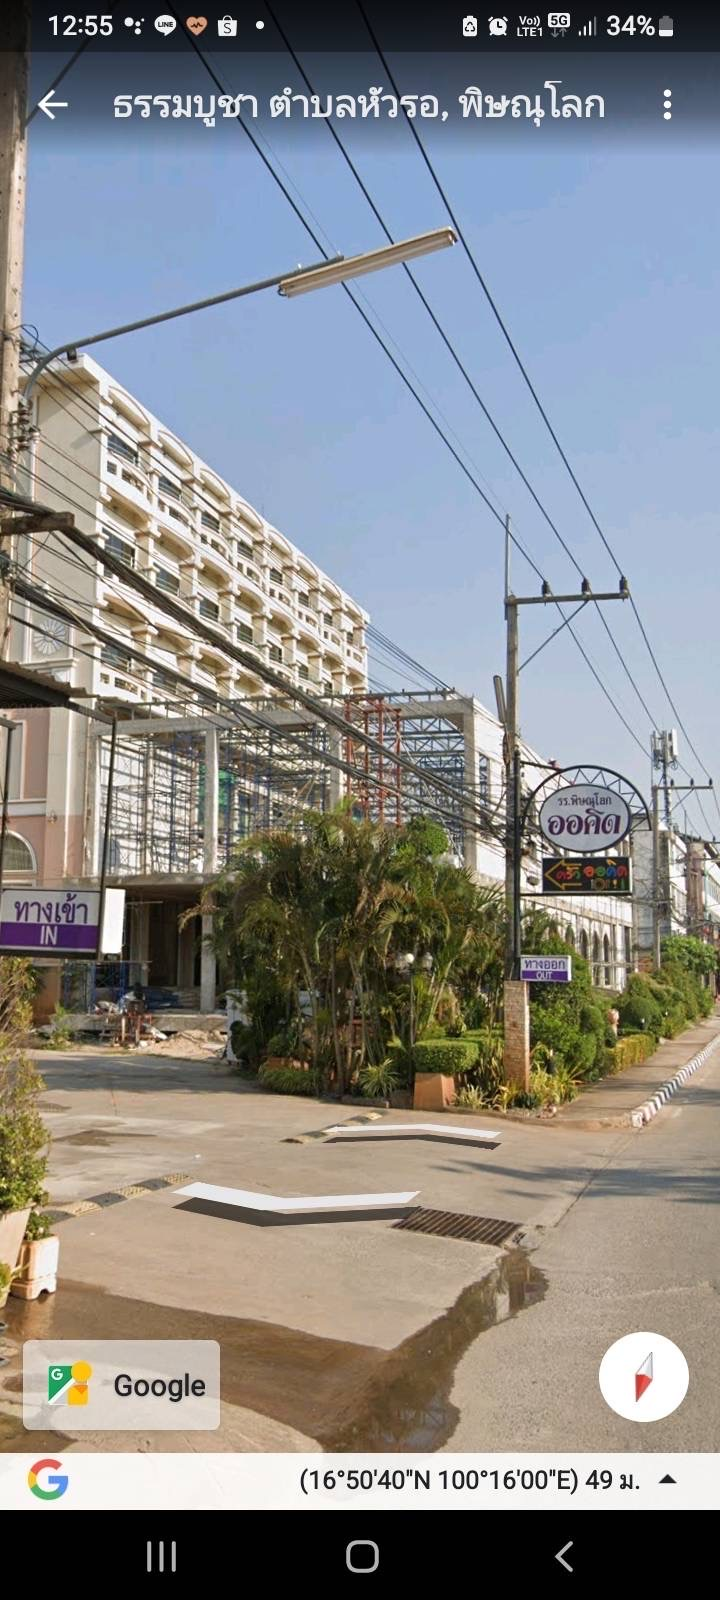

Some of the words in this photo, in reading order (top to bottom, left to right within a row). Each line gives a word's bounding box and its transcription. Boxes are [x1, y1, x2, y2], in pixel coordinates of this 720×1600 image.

[557, 793, 612, 808] รร.พิษณุโลก
[548, 808, 621, 836] ออคิด
[583, 859, 628, 878] ออคิด
[14, 893, 89, 924] ทางเข้า
[40, 926, 58, 946] IN
[524, 959, 566, 970] ทางออก
[536, 971, 553, 980] OUT
